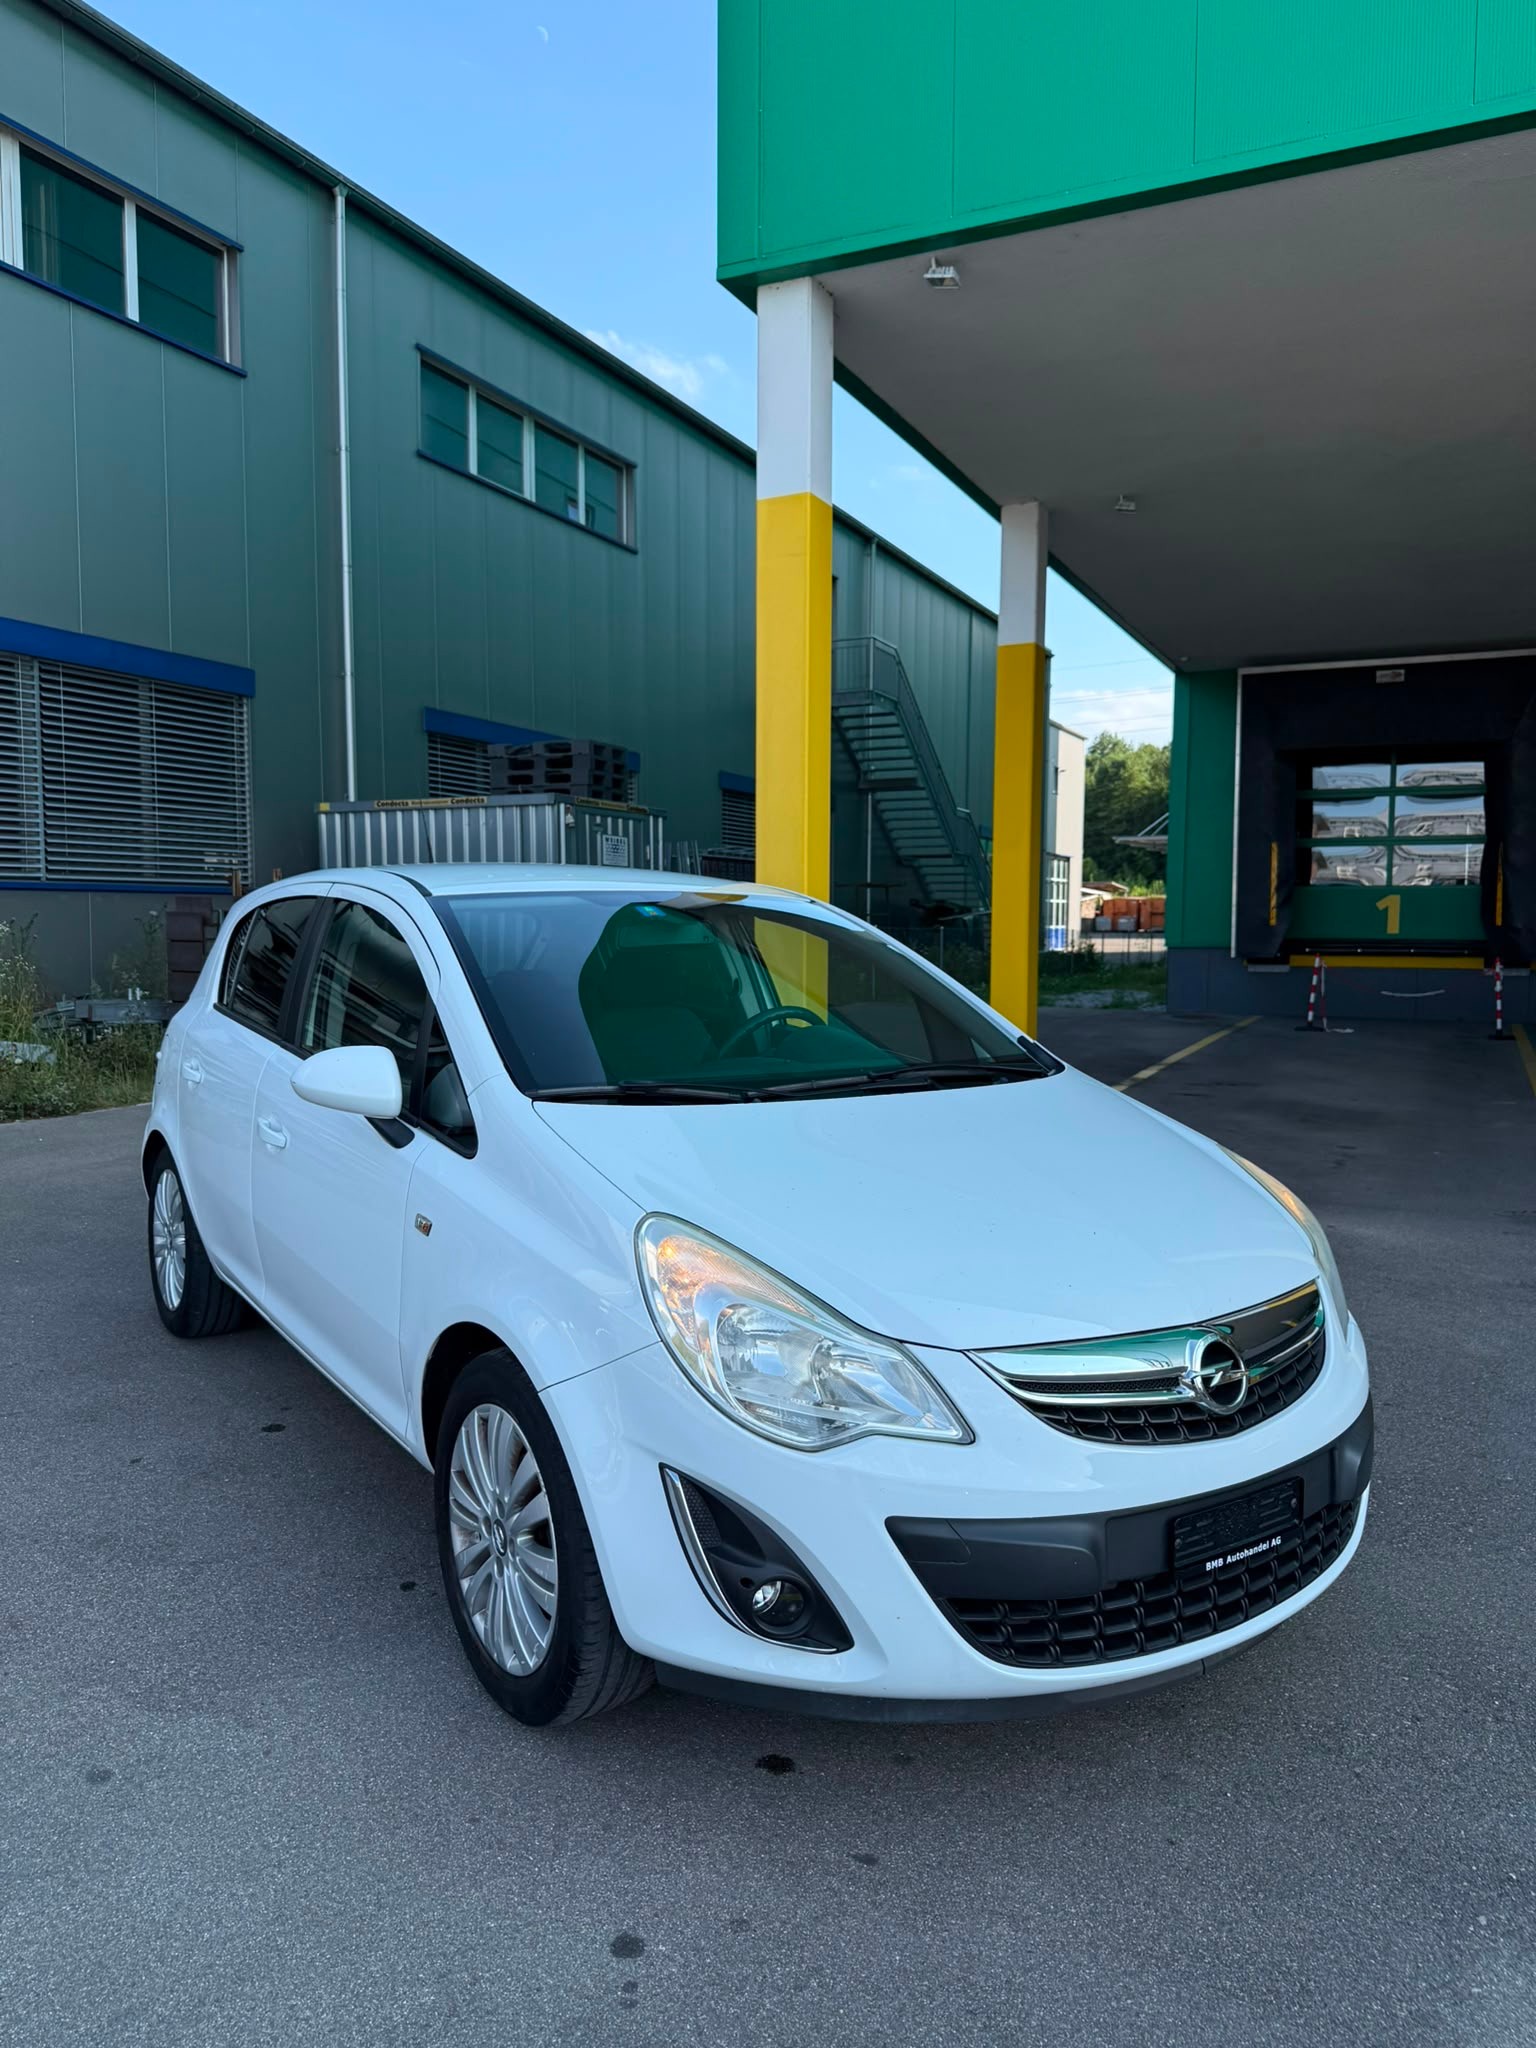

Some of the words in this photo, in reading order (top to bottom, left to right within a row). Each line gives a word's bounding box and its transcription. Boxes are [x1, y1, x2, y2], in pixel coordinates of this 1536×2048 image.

[1376, 894, 1401, 934] 1
[1206, 1558, 1223, 1571] BMB
[1226, 1540, 1269, 1564] Autohandel
[1271, 1536, 1281, 1547] AG
